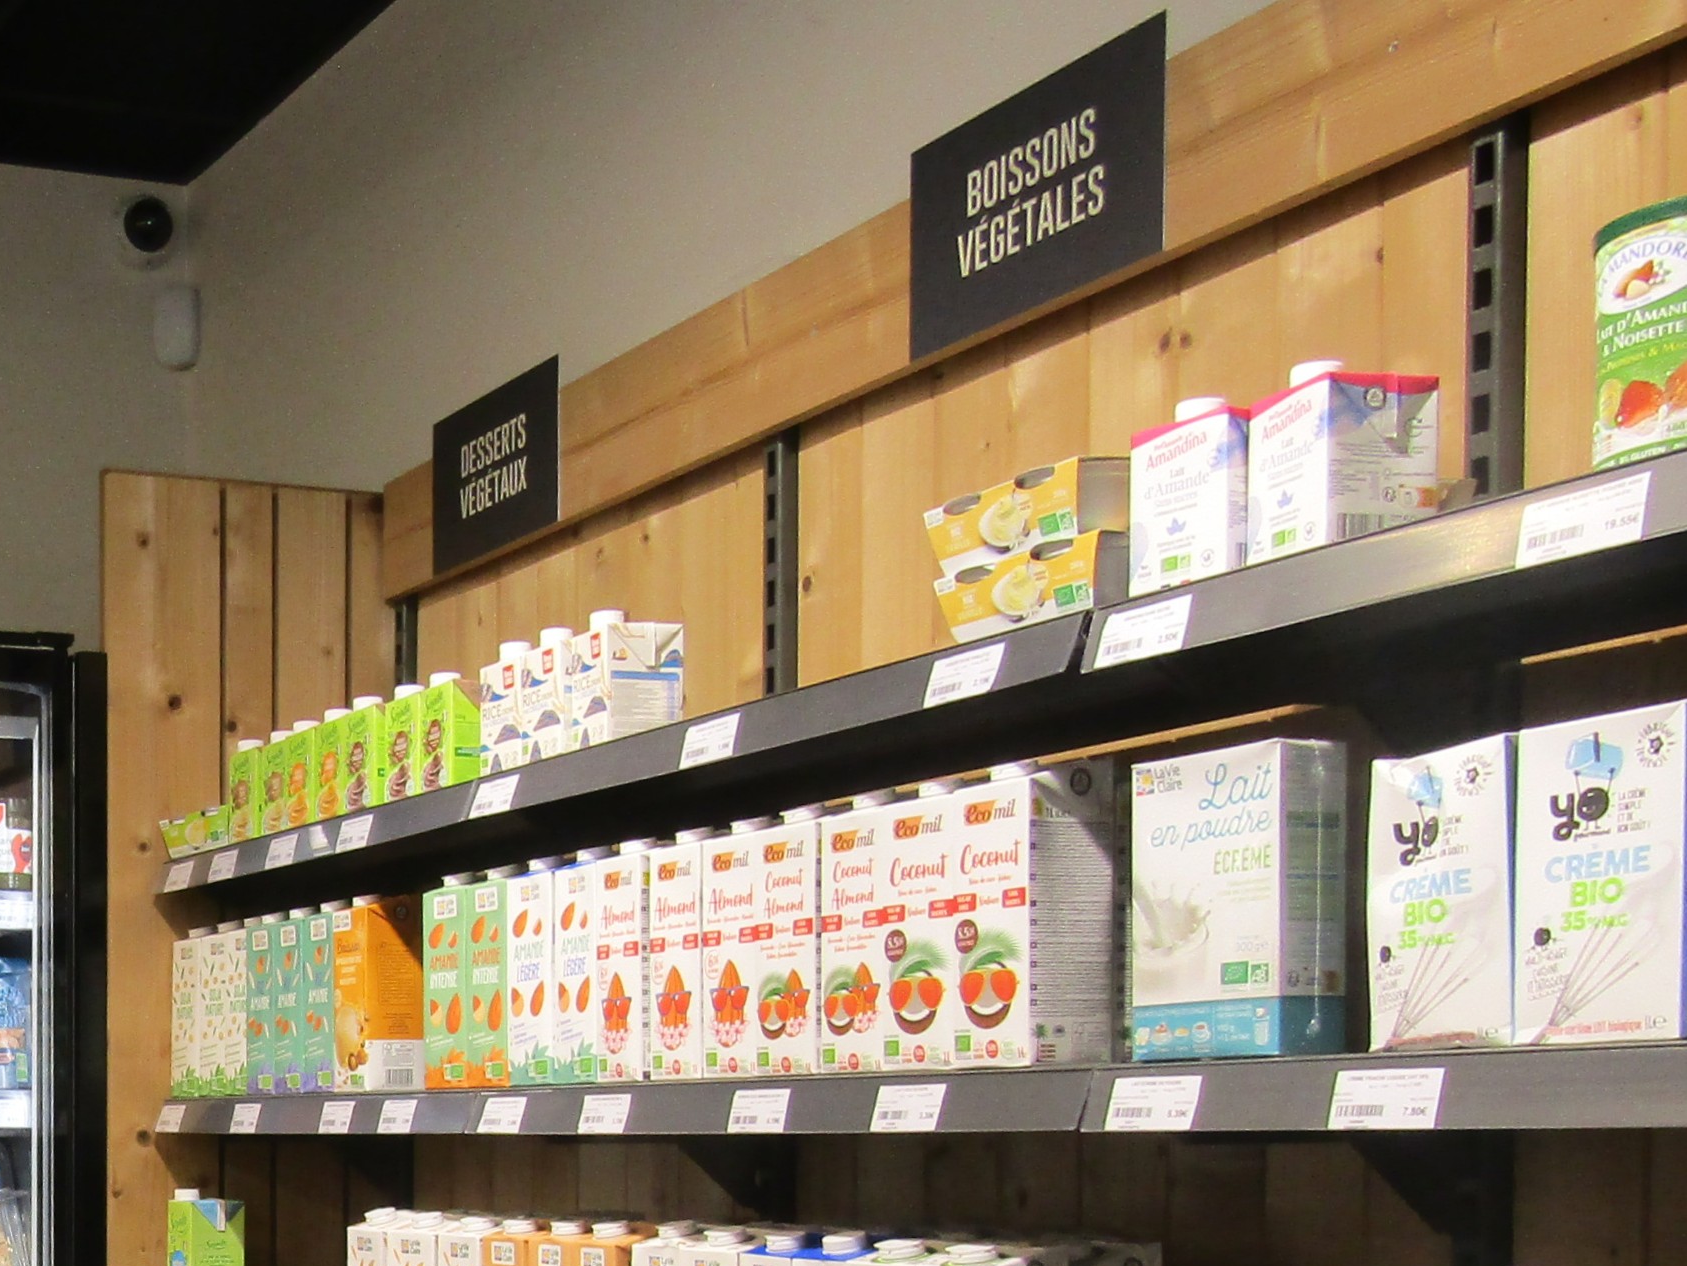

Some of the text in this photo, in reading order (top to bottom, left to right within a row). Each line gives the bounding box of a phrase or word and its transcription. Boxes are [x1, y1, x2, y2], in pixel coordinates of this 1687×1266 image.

[967, 107, 1096, 218] BOISSONS
[957, 165, 1105, 278] VÉGÉTALES
[460, 412, 527, 480] DESSERTS
[1146, 431, 1208, 472] Amandina
[460, 456, 527, 519] VÉGÉTAUX
[483, 704, 502, 720] RICE
[523, 690, 541, 706] RICE
[1199, 762, 1272, 811] Lait
[1150, 806, 1272, 852] en poudre
[833, 858, 874, 883] Coconut
[890, 853, 948, 887] Coconut
[960, 839, 1021, 874] Coconut
[765, 869, 803, 892] Coconut
[1570, 877, 1625, 908] BIO
[655, 892, 695, 921] Almond
[708, 884, 753, 915] Almond
[764, 894, 804, 919] Almond
[832, 884, 874, 910] Almond
[601, 901, 635, 930] Almond
[1403, 899, 1448, 927] BIO
[472, 947, 501, 965] AMANDE
[514, 940, 544, 963] AMANDE
[561, 934, 590, 955] AMANDE
[430, 953, 458, 970] AMANDE
